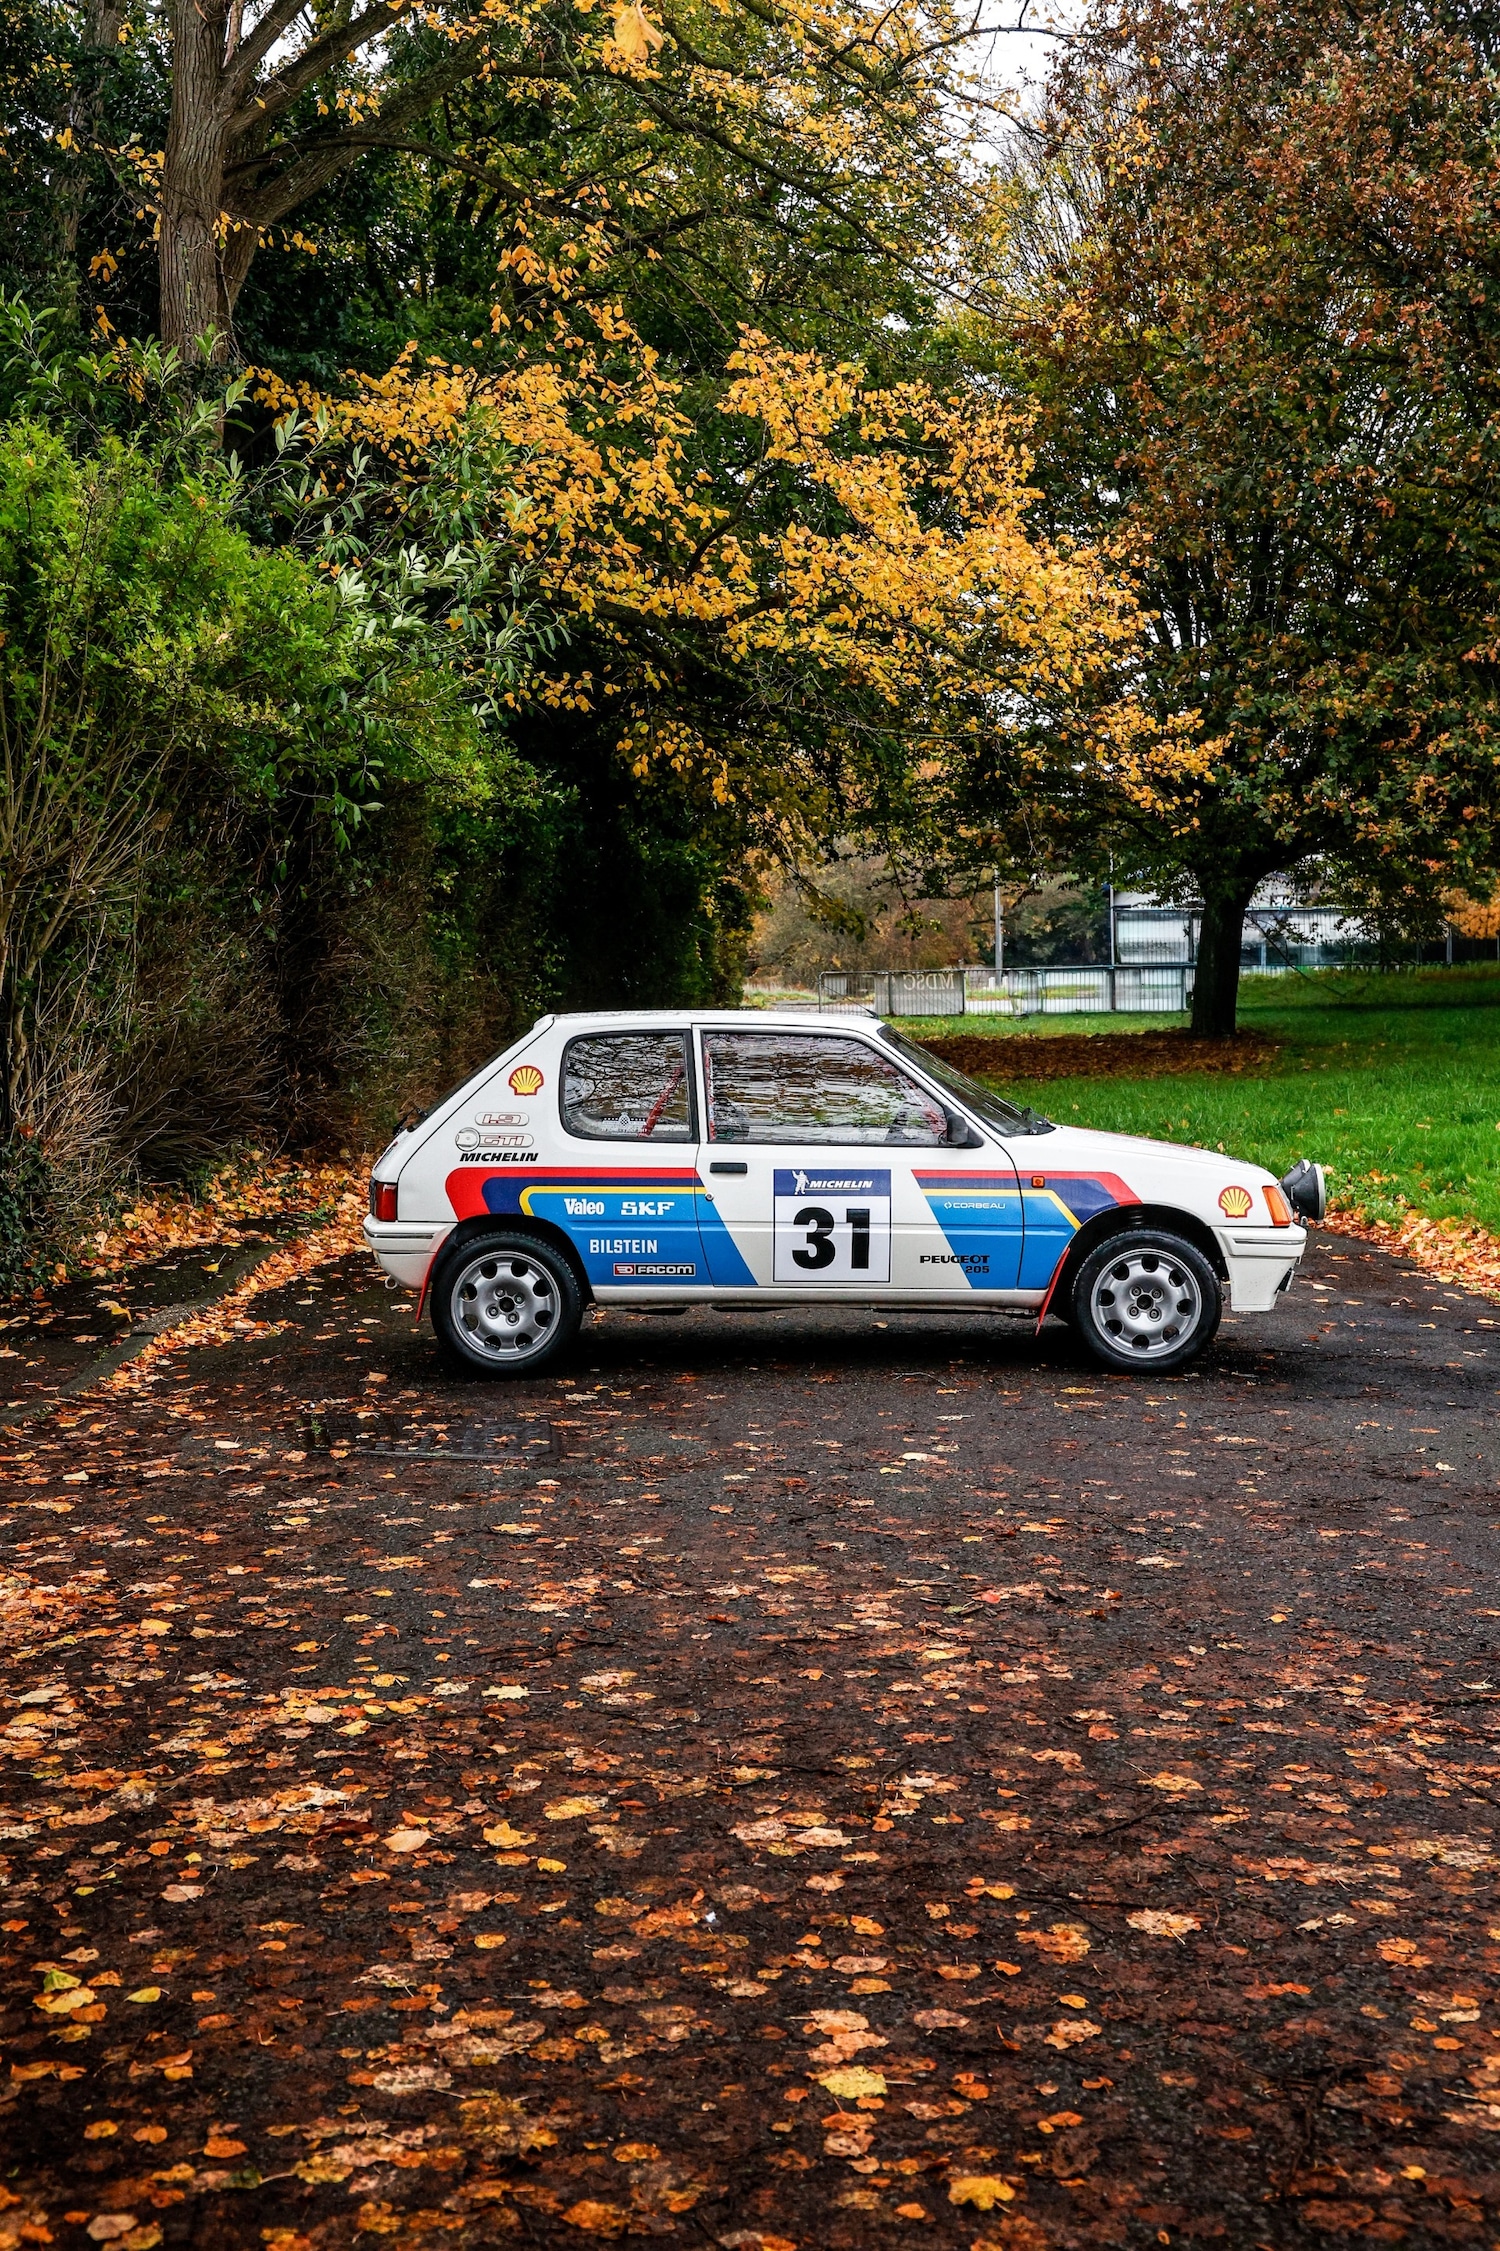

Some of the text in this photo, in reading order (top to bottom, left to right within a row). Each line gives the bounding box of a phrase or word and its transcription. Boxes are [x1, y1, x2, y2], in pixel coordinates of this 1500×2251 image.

[484, 1135, 524, 1146] GTI
[460, 1153, 539, 1162] MICHELIN
[564, 1198, 605, 1215] Valeo
[621, 1202, 675, 1215] SKF
[792, 1207, 870, 1269] 31
[590, 1239, 658, 1254] BILSTEIN
[920, 1255, 990, 1264] PEUGEOT
[637, 1265, 693, 1274] FACOM
